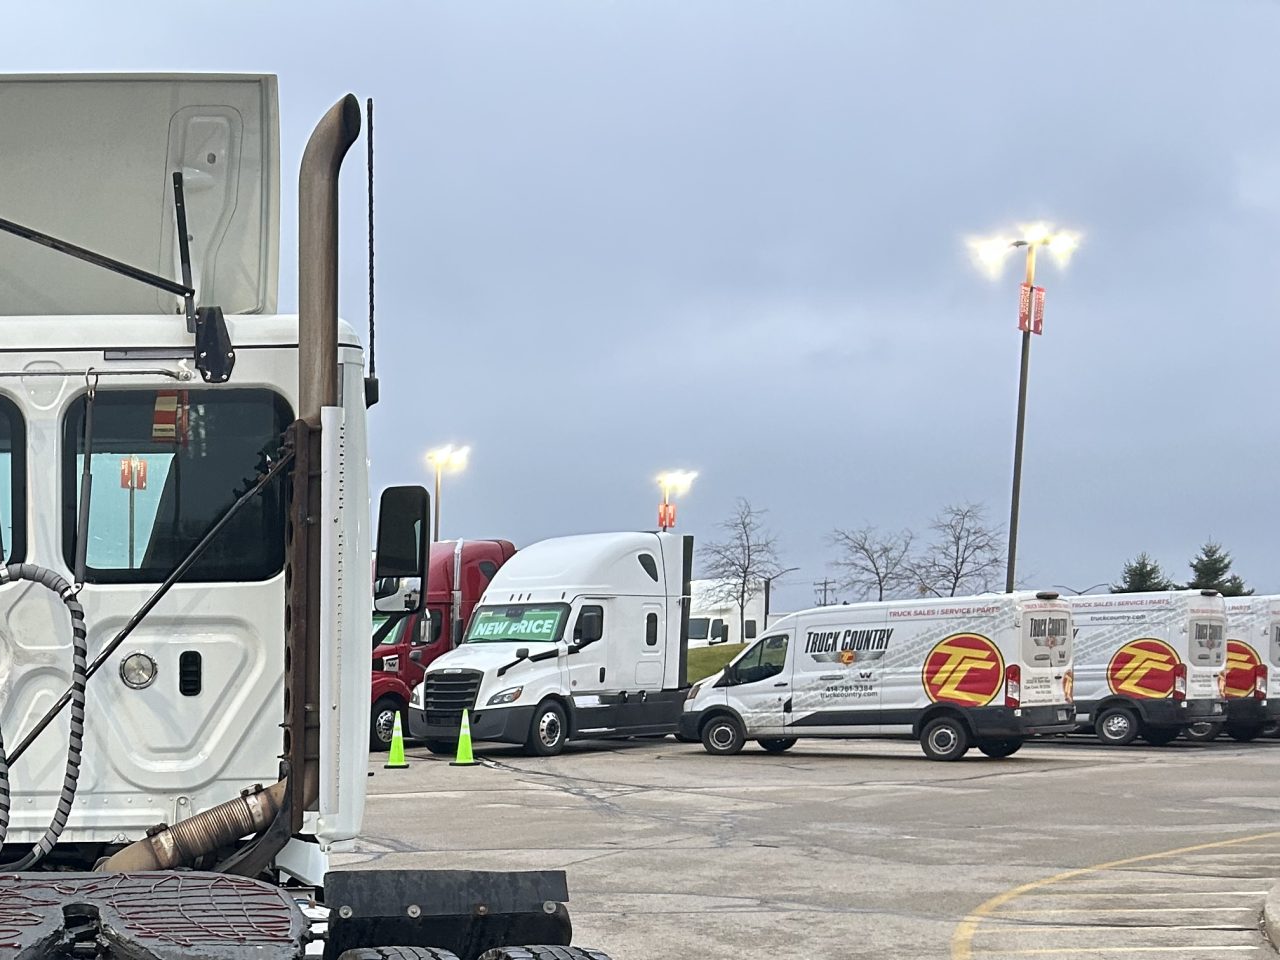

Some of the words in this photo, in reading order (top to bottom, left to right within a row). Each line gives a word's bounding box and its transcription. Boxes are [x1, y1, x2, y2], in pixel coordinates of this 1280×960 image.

[940, 607, 971, 615] SERVICE
[474, 621, 508, 636] NEW
[508, 619, 554, 635] PRICE
[805, 631, 841, 653] TRUCK
[841, 628, 895, 651] COUNTRY
